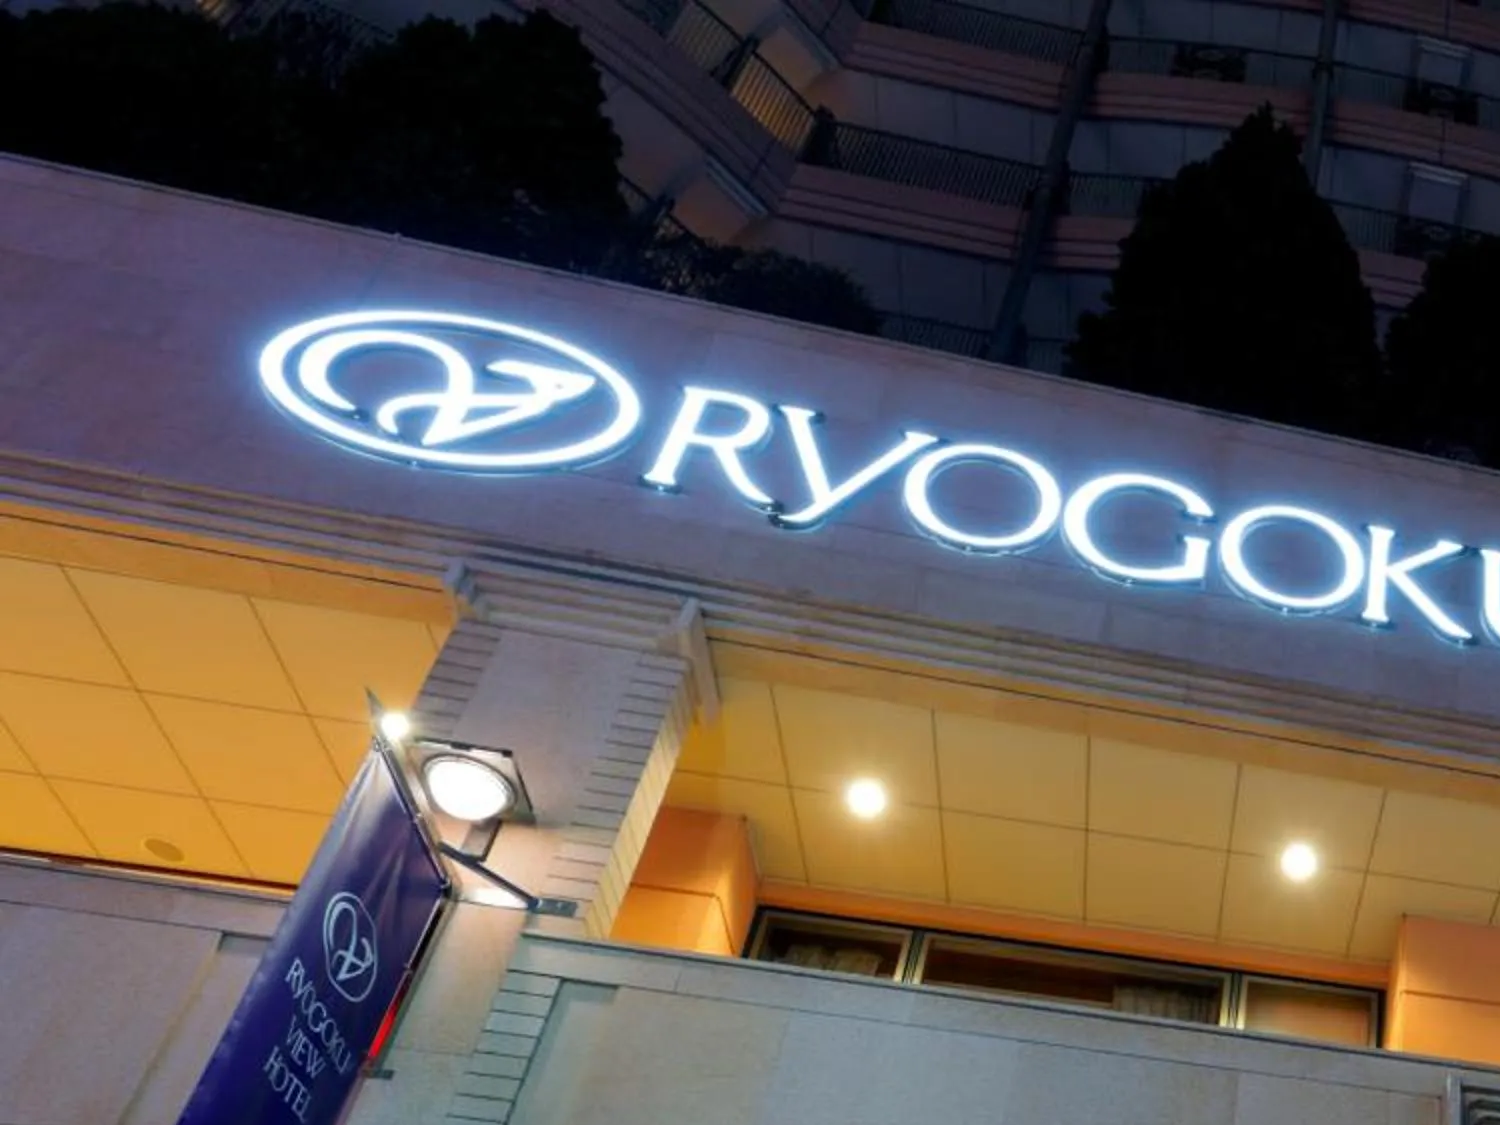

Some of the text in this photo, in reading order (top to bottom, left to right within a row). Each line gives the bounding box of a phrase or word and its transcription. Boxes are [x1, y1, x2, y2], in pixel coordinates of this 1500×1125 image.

[284, 956, 352, 1077] RYOGOKU
[286, 1015, 327, 1079] VIEW
[263, 1045, 312, 1124] HOTEL
